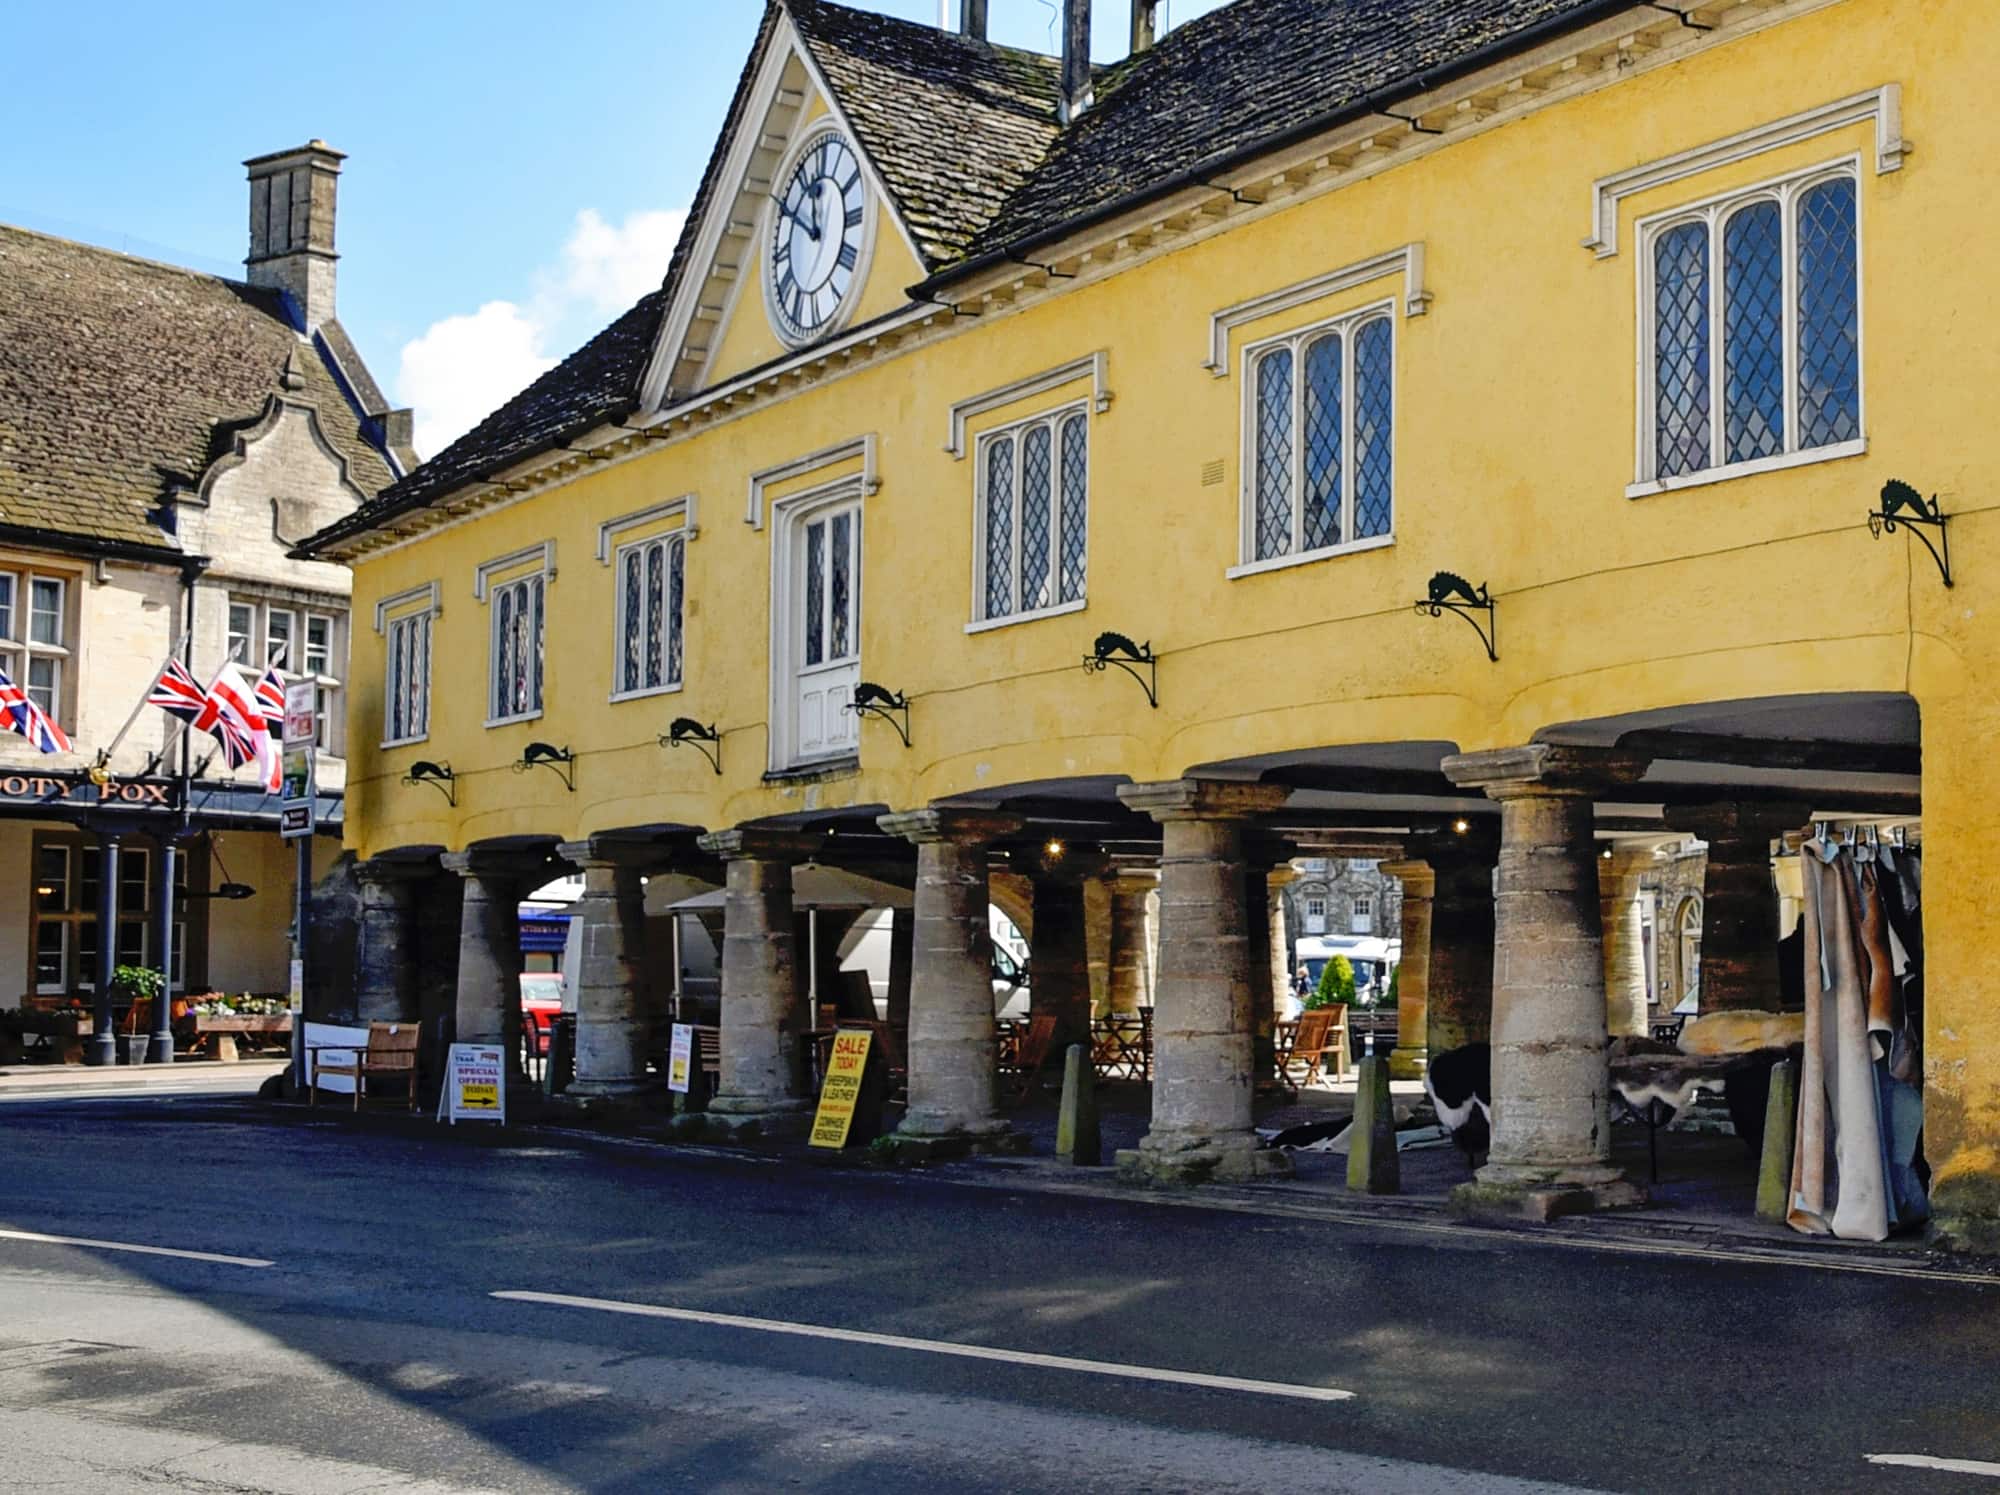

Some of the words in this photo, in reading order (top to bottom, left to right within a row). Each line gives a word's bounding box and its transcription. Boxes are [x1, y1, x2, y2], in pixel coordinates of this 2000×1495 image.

[0, 776, 71, 798] OTY
[98, 782, 169, 803] FOX
[835, 1038, 868, 1055] SALE
[836, 1056, 858, 1070] TODAY
[458, 1067, 498, 1075] SPECIAL
[466, 1086, 494, 1094] TODAY
[828, 1088, 855, 1101] LEATHER
